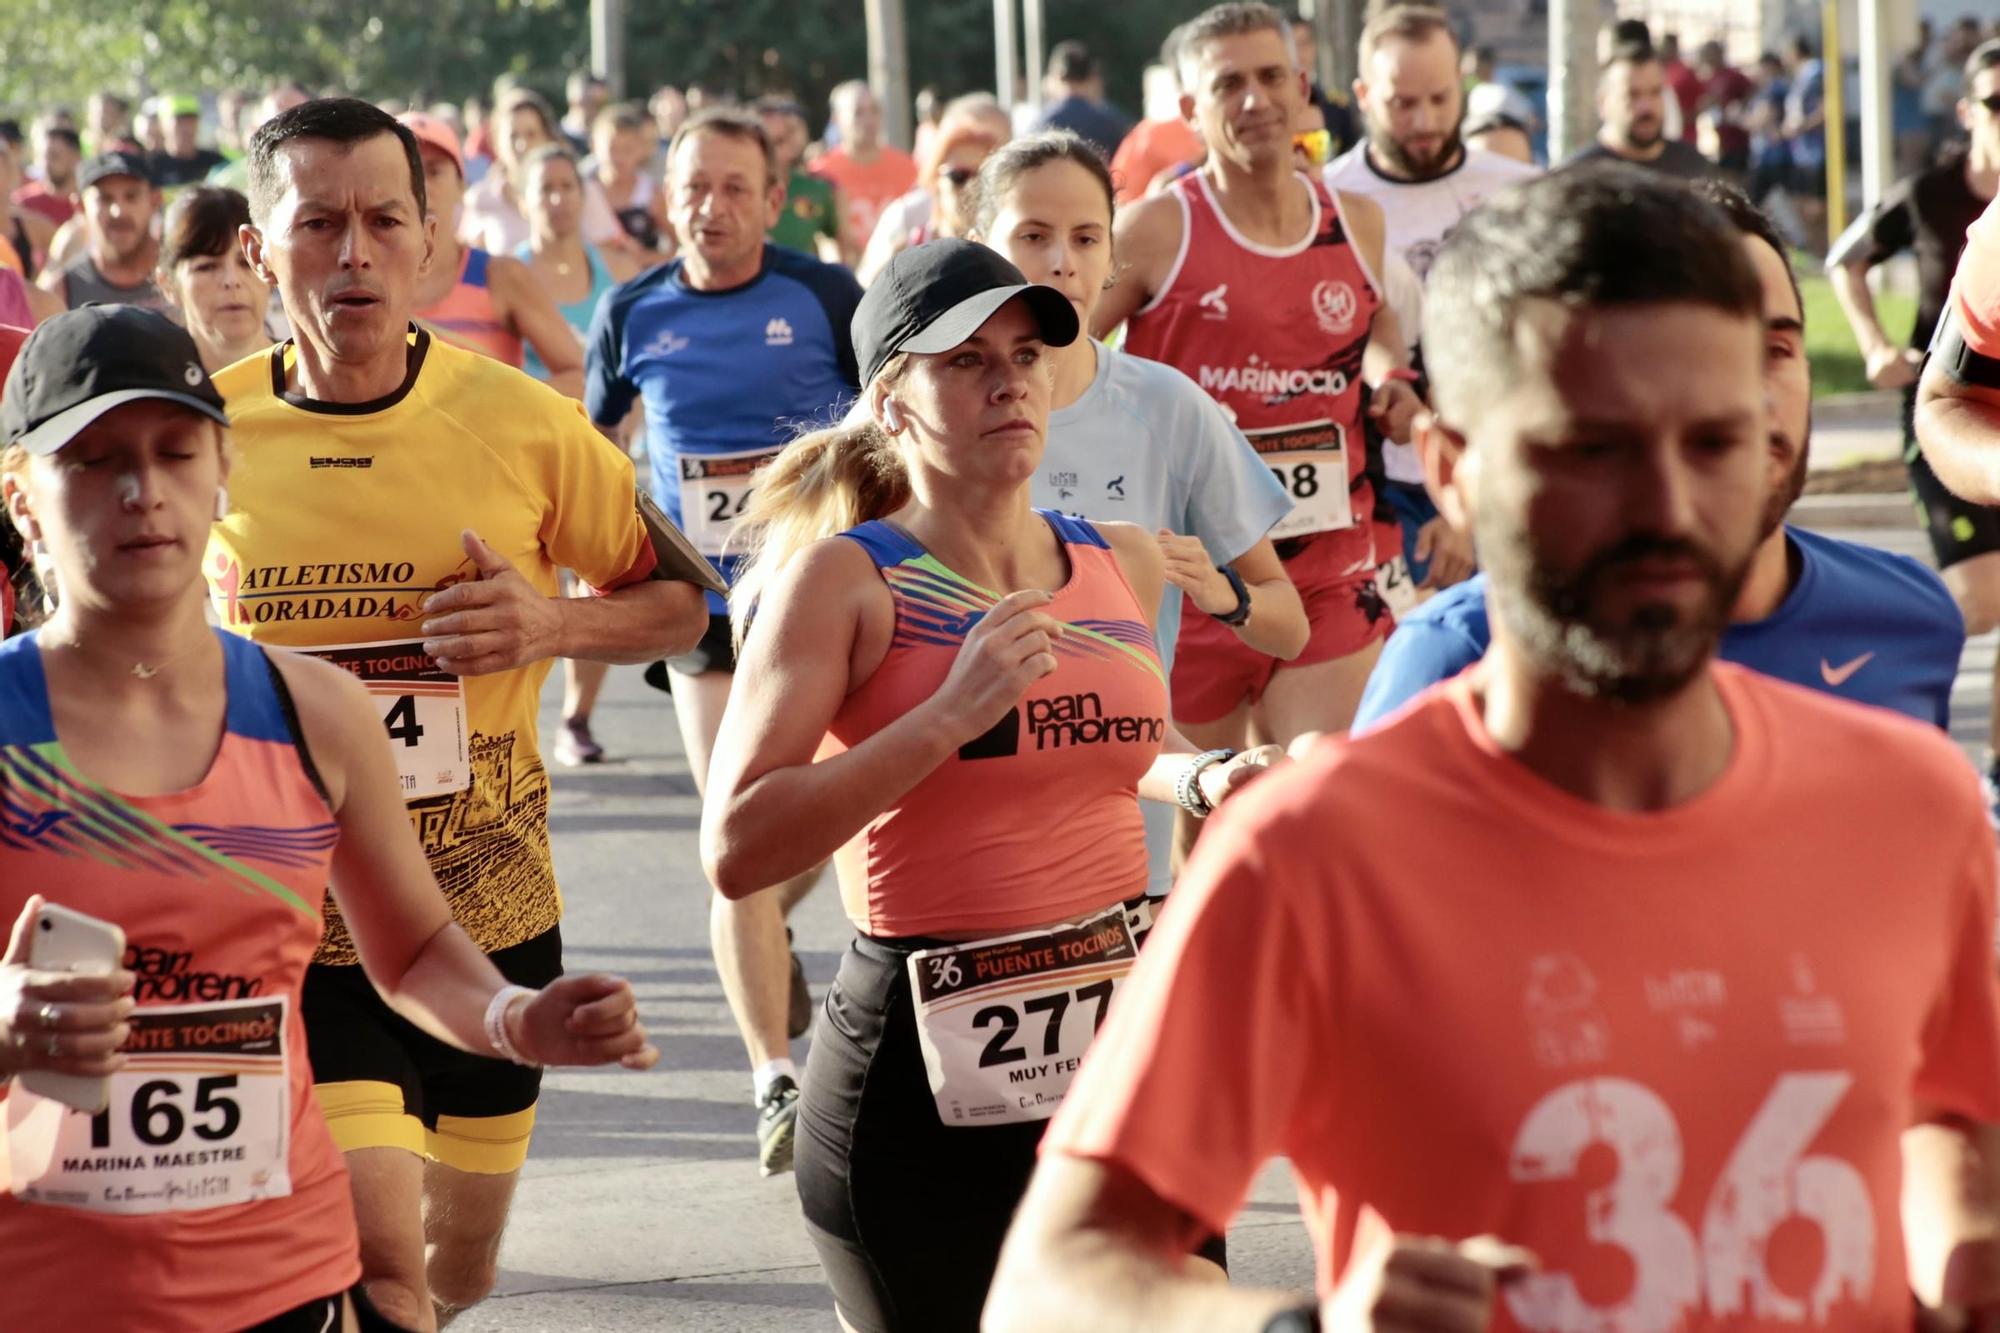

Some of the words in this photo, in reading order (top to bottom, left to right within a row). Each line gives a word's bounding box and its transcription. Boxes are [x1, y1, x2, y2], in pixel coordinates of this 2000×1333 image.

[241, 562, 414, 590] ATLETISMO
[255, 597, 398, 623] ORADADA
[366, 656, 436, 674] TOCINO
[1027, 692, 1102, 734] pan
[1037, 716, 1164, 750] moreno
[976, 950, 1055, 978] PUENTE
[1061, 926, 1124, 960] TOCINOS
[929, 956, 962, 989] 36
[180, 1020, 274, 1046] TOCINOS
[1009, 1065, 1048, 1083] MUY
[62, 1156, 145, 1173] MARINA
[154, 1146, 246, 1168] MAESTRE
[1507, 1070, 1876, 1333] 36
